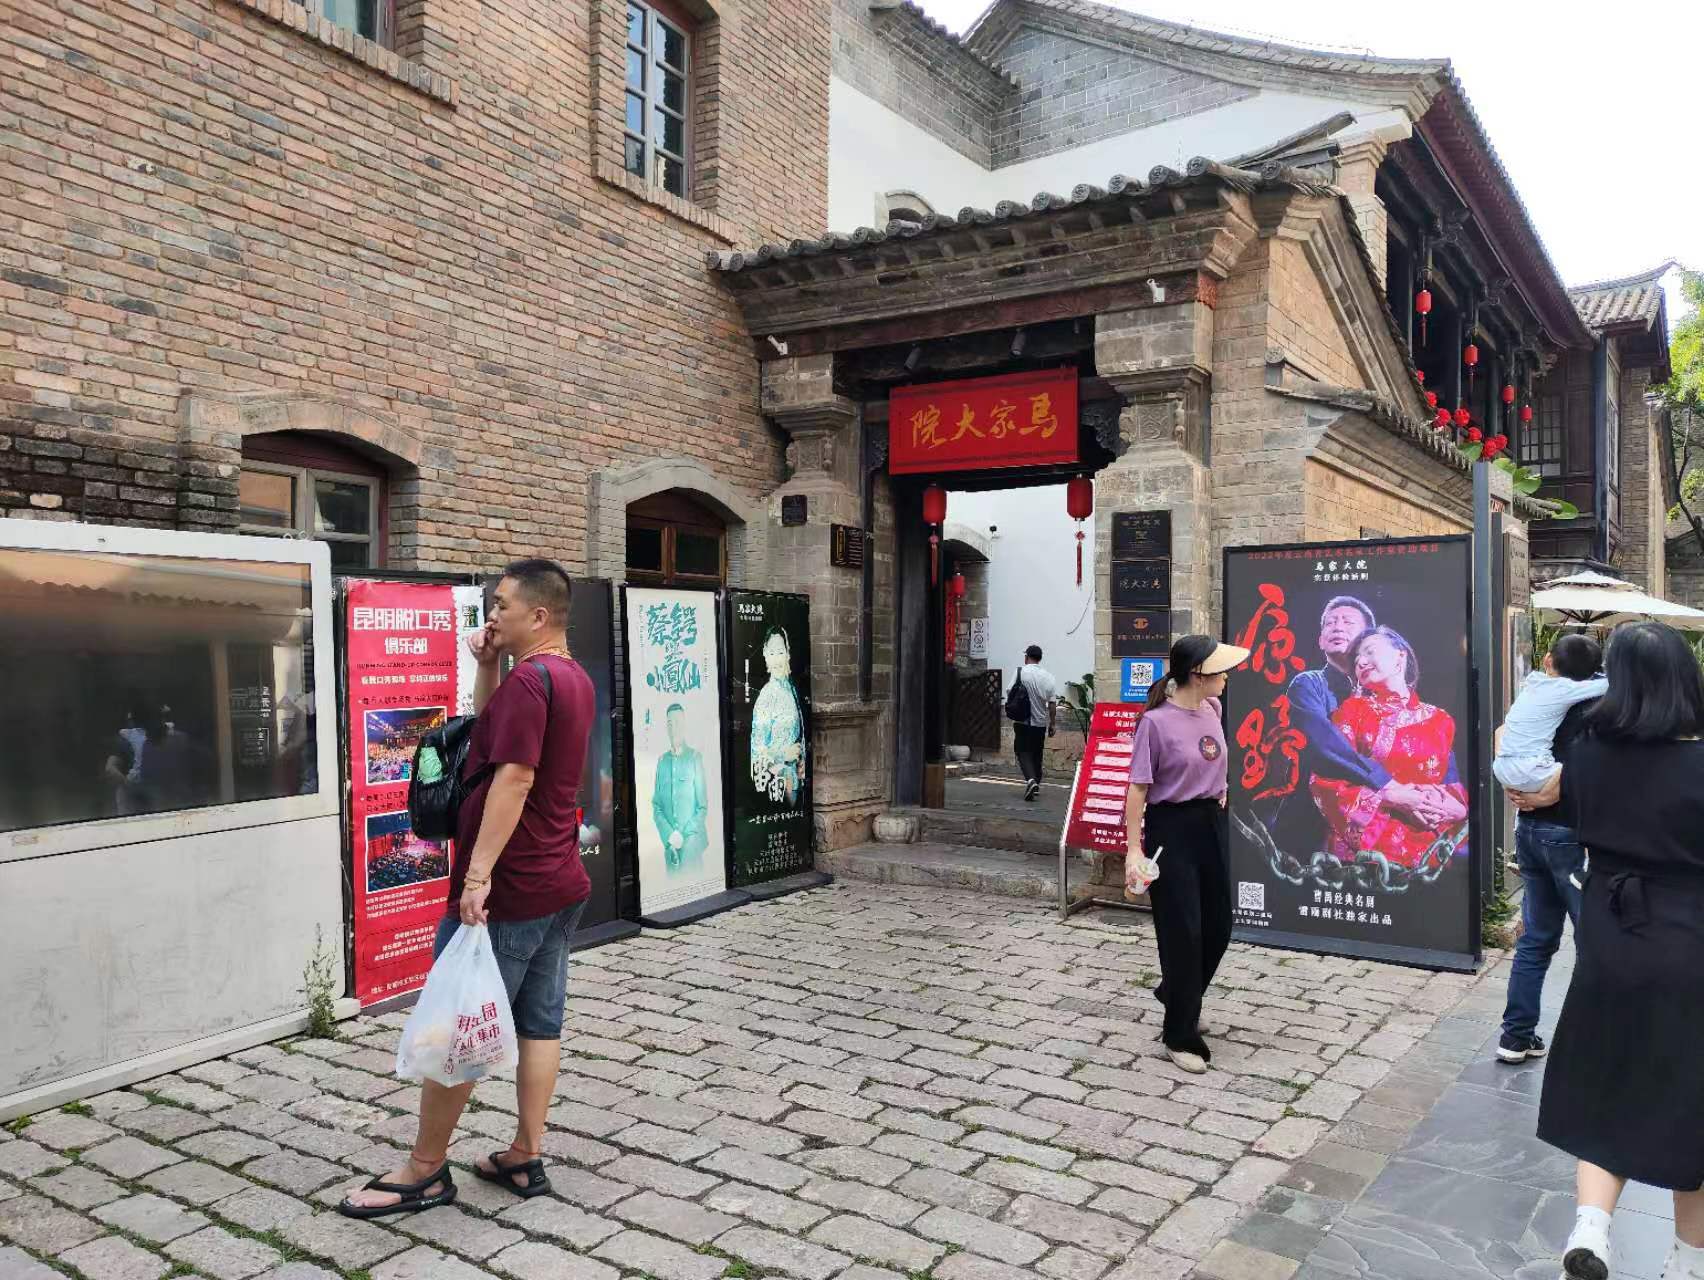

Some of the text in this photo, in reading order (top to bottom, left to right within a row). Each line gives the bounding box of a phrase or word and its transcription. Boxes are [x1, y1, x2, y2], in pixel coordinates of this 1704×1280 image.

[1314, 559, 1368, 572] 马家大院
[353, 607, 452, 632] 昆明脱口秀
[384, 637, 428, 655] 俱乐部
[1313, 889, 1375, 909] 曹禺经典名剧
